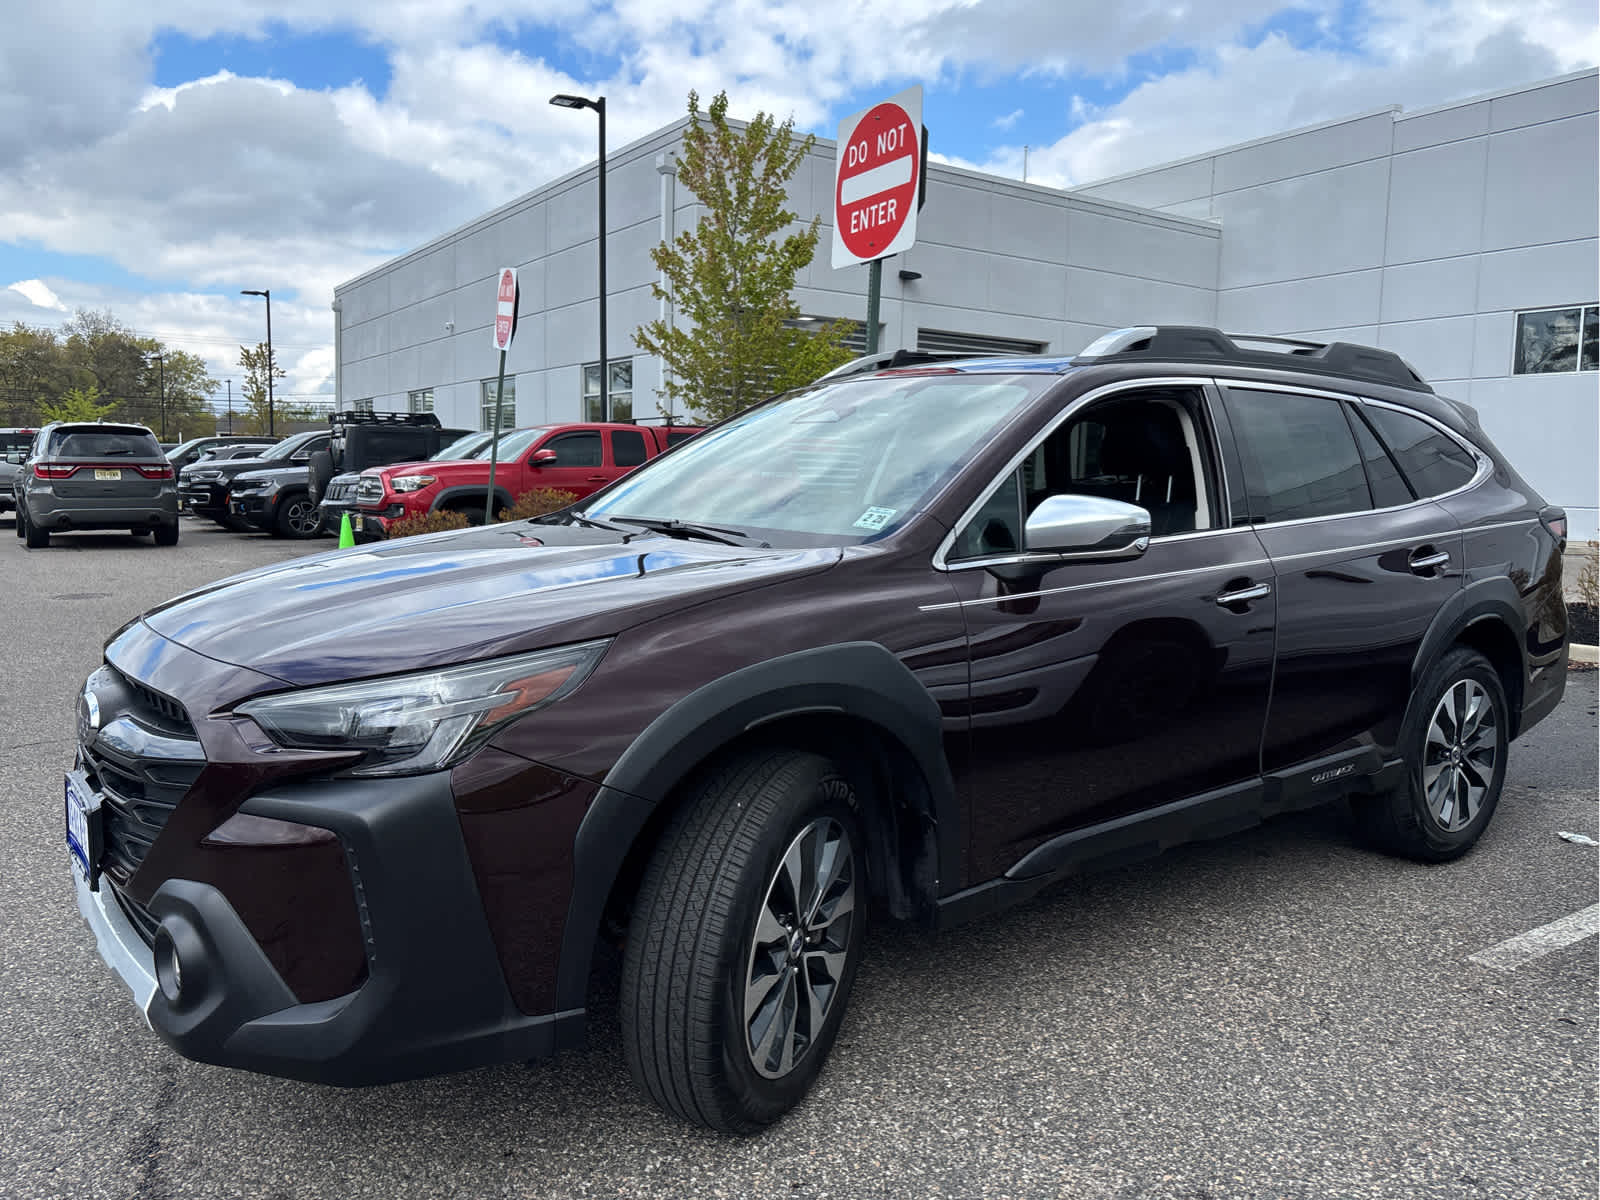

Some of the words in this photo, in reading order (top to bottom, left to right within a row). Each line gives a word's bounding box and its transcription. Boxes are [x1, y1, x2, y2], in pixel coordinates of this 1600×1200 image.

[849, 140, 868, 168] DO
[876, 123, 907, 157] NOT
[850, 198, 897, 235] ENTER
